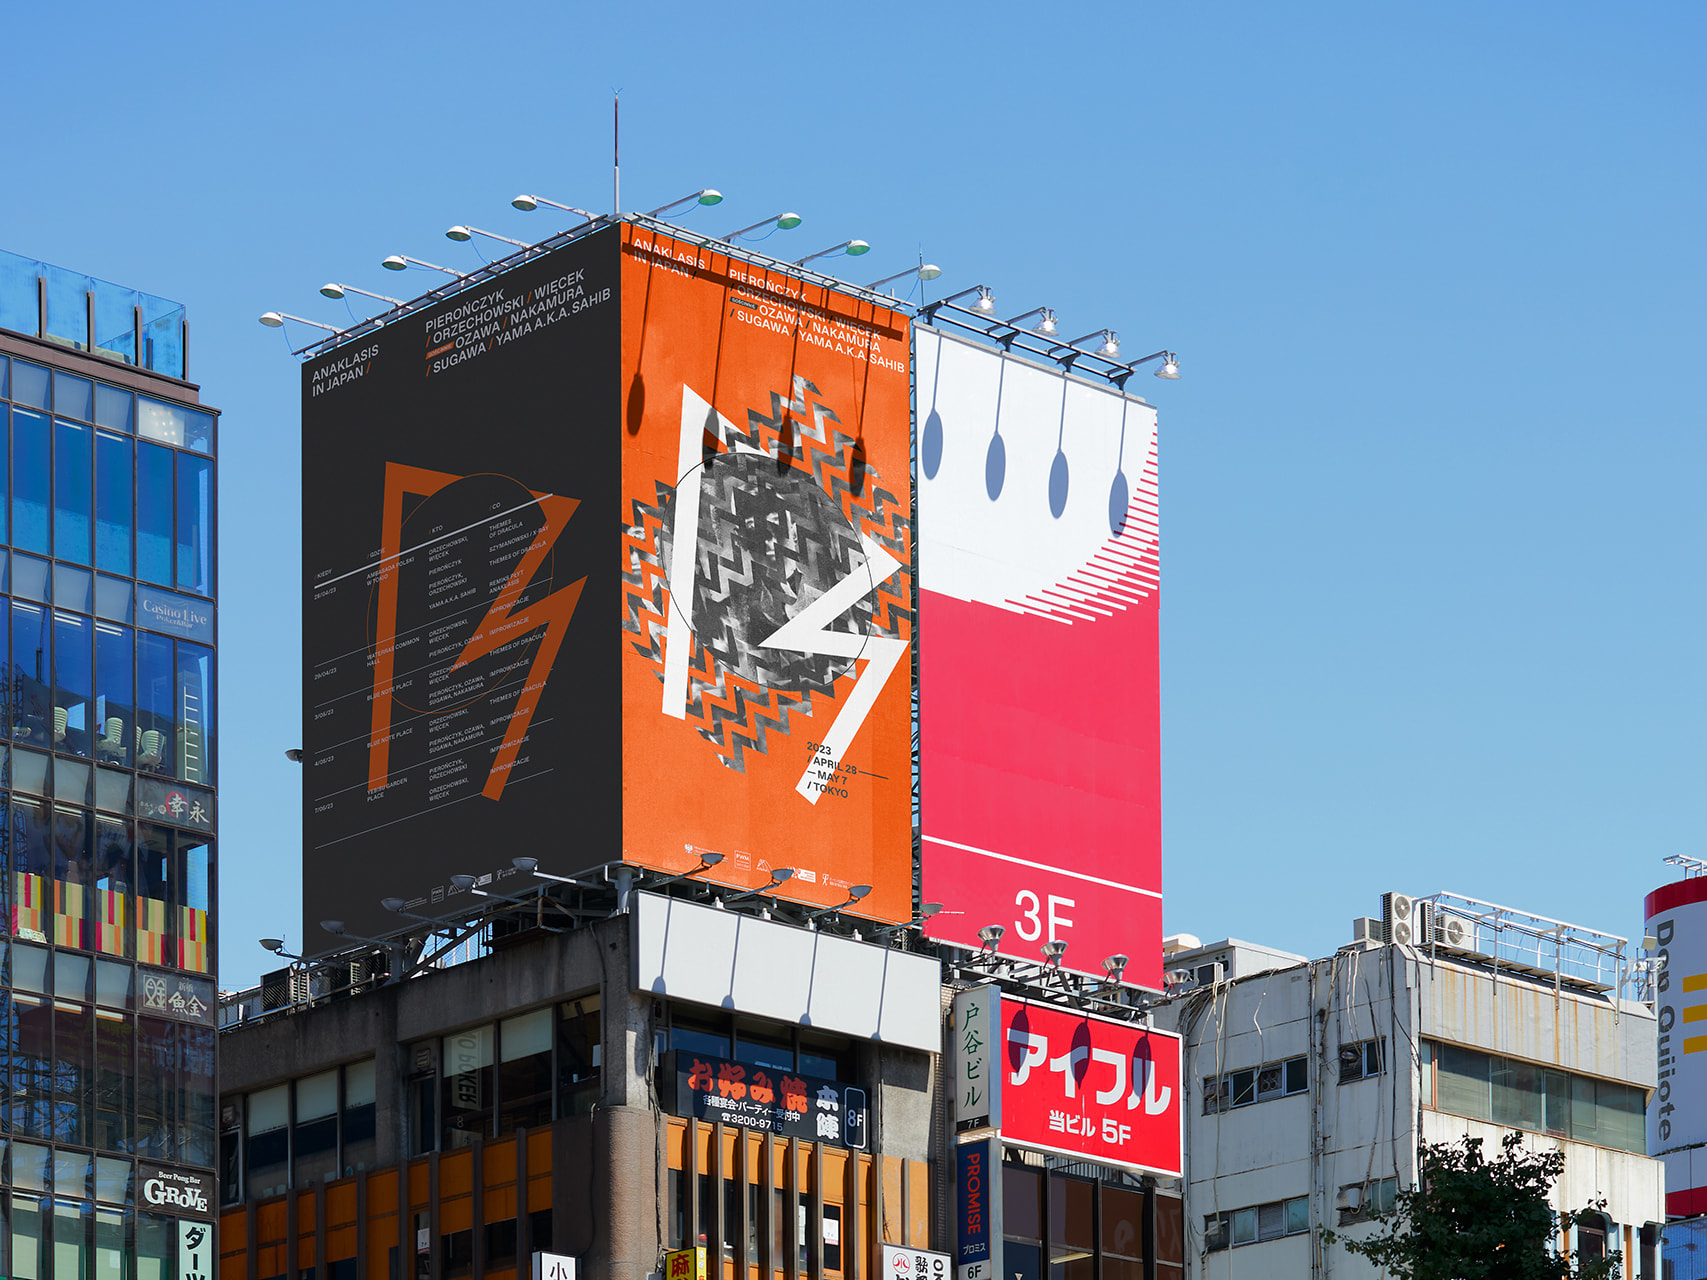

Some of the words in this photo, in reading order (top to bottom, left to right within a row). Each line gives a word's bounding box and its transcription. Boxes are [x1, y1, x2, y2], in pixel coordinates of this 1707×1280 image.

[634, 239, 705, 270] ANAKLASIS
[634, 251, 647, 264] IN
[650, 256, 689, 278] JAPAN
[729, 269, 807, 303] PIEROŃCZYK
[425, 288, 505, 333] PIEROŃCZYK
[433, 294, 524, 345] ORZECHOWSKI
[534, 268, 585, 303] WIĘCEK
[455, 321, 500, 349] OZAWA
[510, 284, 584, 326] NAKAMURA
[737, 285, 826, 323] ORZECHOWSKI
[835, 316, 881, 342] WIĘCEK
[433, 344, 486, 373] SUGAWA
[496, 325, 532, 347] YAMA
[534, 311, 571, 331] A.K.A.
[572, 287, 612, 315] SAHIB
[737, 311, 790, 337] SUGAWA
[799, 330, 833, 350] YAMA
[835, 343, 870, 363] A.K.A.
[870, 353, 905, 374] SAHIB
[759, 305, 803, 328] OZAWA
[813, 323, 881, 353] NAKAMURA
[312, 344, 379, 383] ANAKLASIS
[312, 382, 325, 397] IN
[327, 365, 364, 391] JAPAN
[143, 599, 182, 619] Casino
[183, 609, 208, 625] Live
[807, 741, 832, 755] 2023
[813, 756, 844, 772] APRIL
[845, 764, 857, 775] 28
[813, 781, 848, 799] TOKYO
[817, 770, 840, 783] MAY
[841, 776, 848, 785] 7
[1014, 889, 1075, 942] 3F
[1656, 919, 1675, 993] Don
[961, 1001, 983, 1109] 戸谷ビル
[1007, 1027, 1172, 1115] アイフル
[1657, 1004, 1676, 1142] Quijote
[687, 1057, 809, 1114] お好み焼
[815, 1084, 840, 1141] 本陣
[847, 1108, 864, 1128] 8F
[967, 1117, 980, 1129] 7F
[1048, 1109, 1096, 1138] 当ビル
[1102, 1120, 1132, 1146] 5F
[143, 1178, 208, 1213] GROVE
[158, 1170, 174, 1181] Beer
[173, 1173, 189, 1185] Pong
[189, 1176, 201, 1185] Bar
[966, 1152, 981, 1235] PROMISE
[962, 1242, 986, 1256] プロミス
[967, 1264, 982, 1280] 6F
